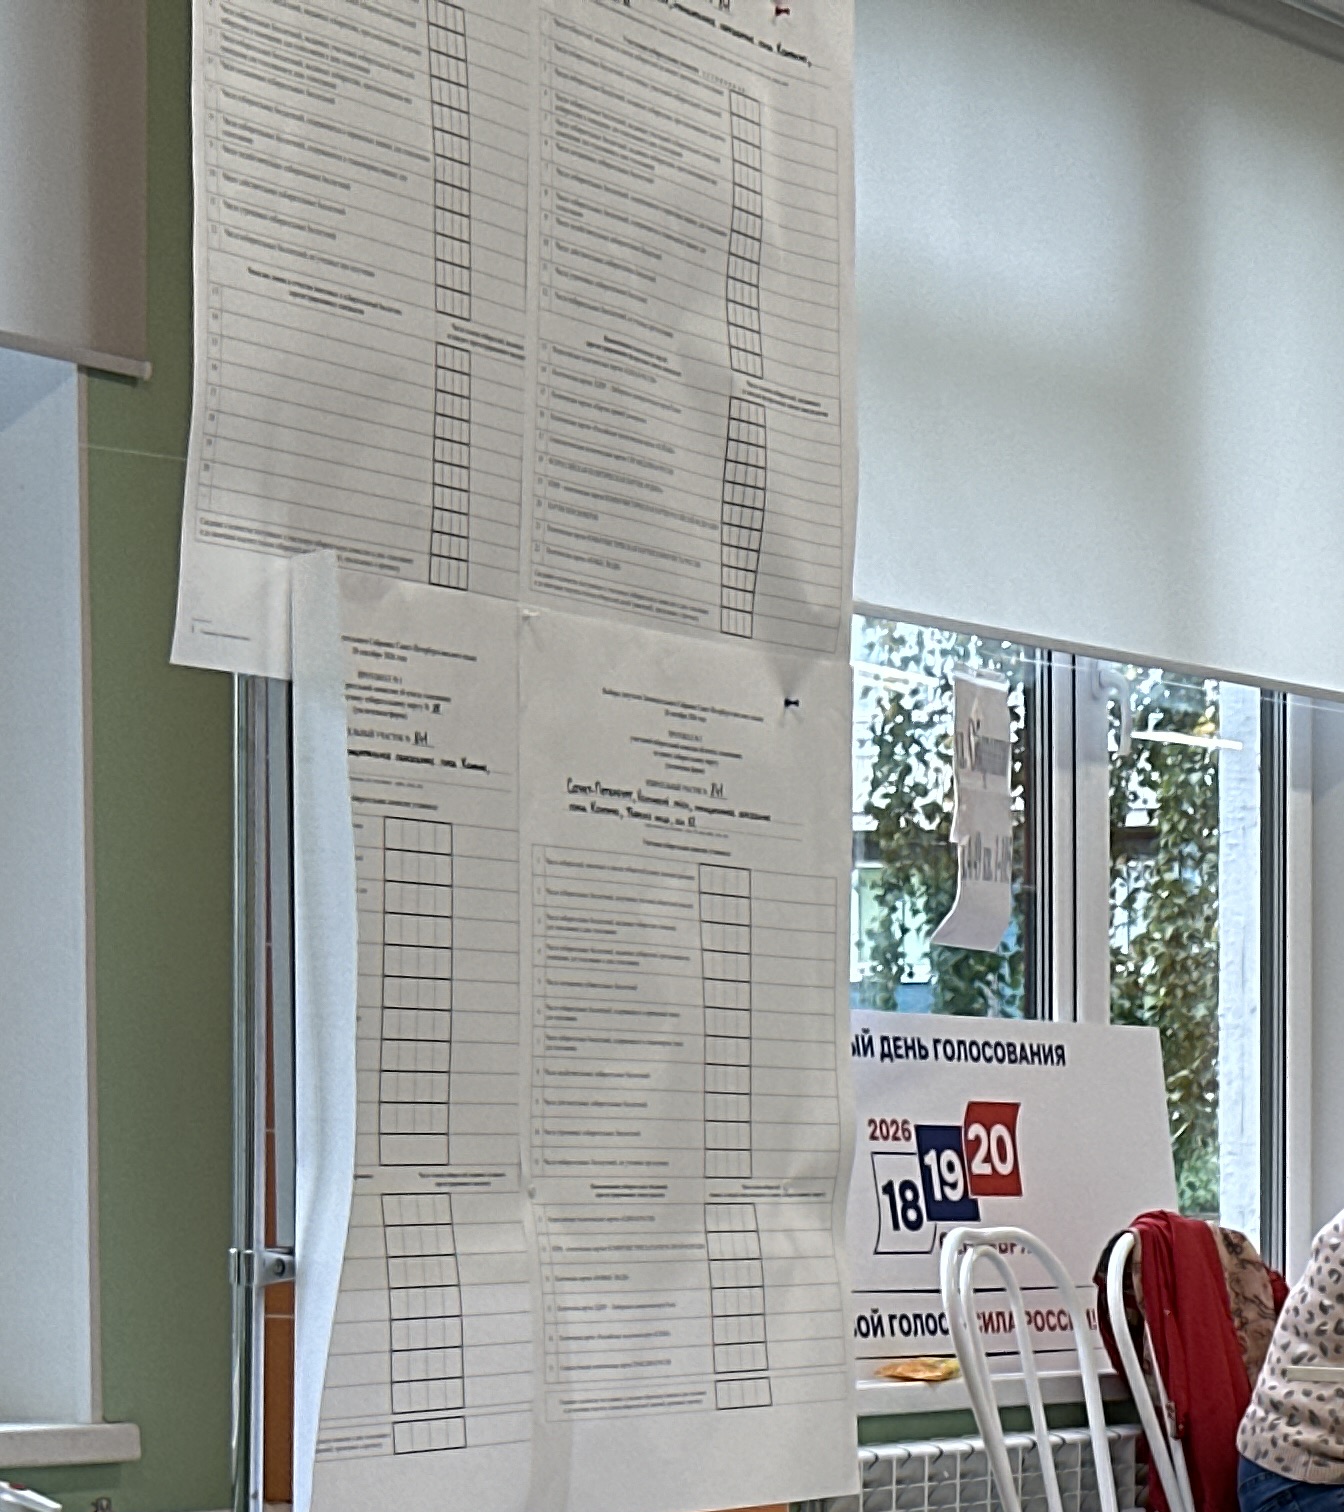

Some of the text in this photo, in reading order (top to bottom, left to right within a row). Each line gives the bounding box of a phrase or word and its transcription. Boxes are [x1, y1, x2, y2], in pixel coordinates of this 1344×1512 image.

[880, 1035, 929, 1063] ДЕНЬ
[933, 1036, 1067, 1068] ГОЛОСОВАНИЯ
[867, 1117, 912, 1143] 2026
[881, 1123, 1015, 1233] 18 19 20
